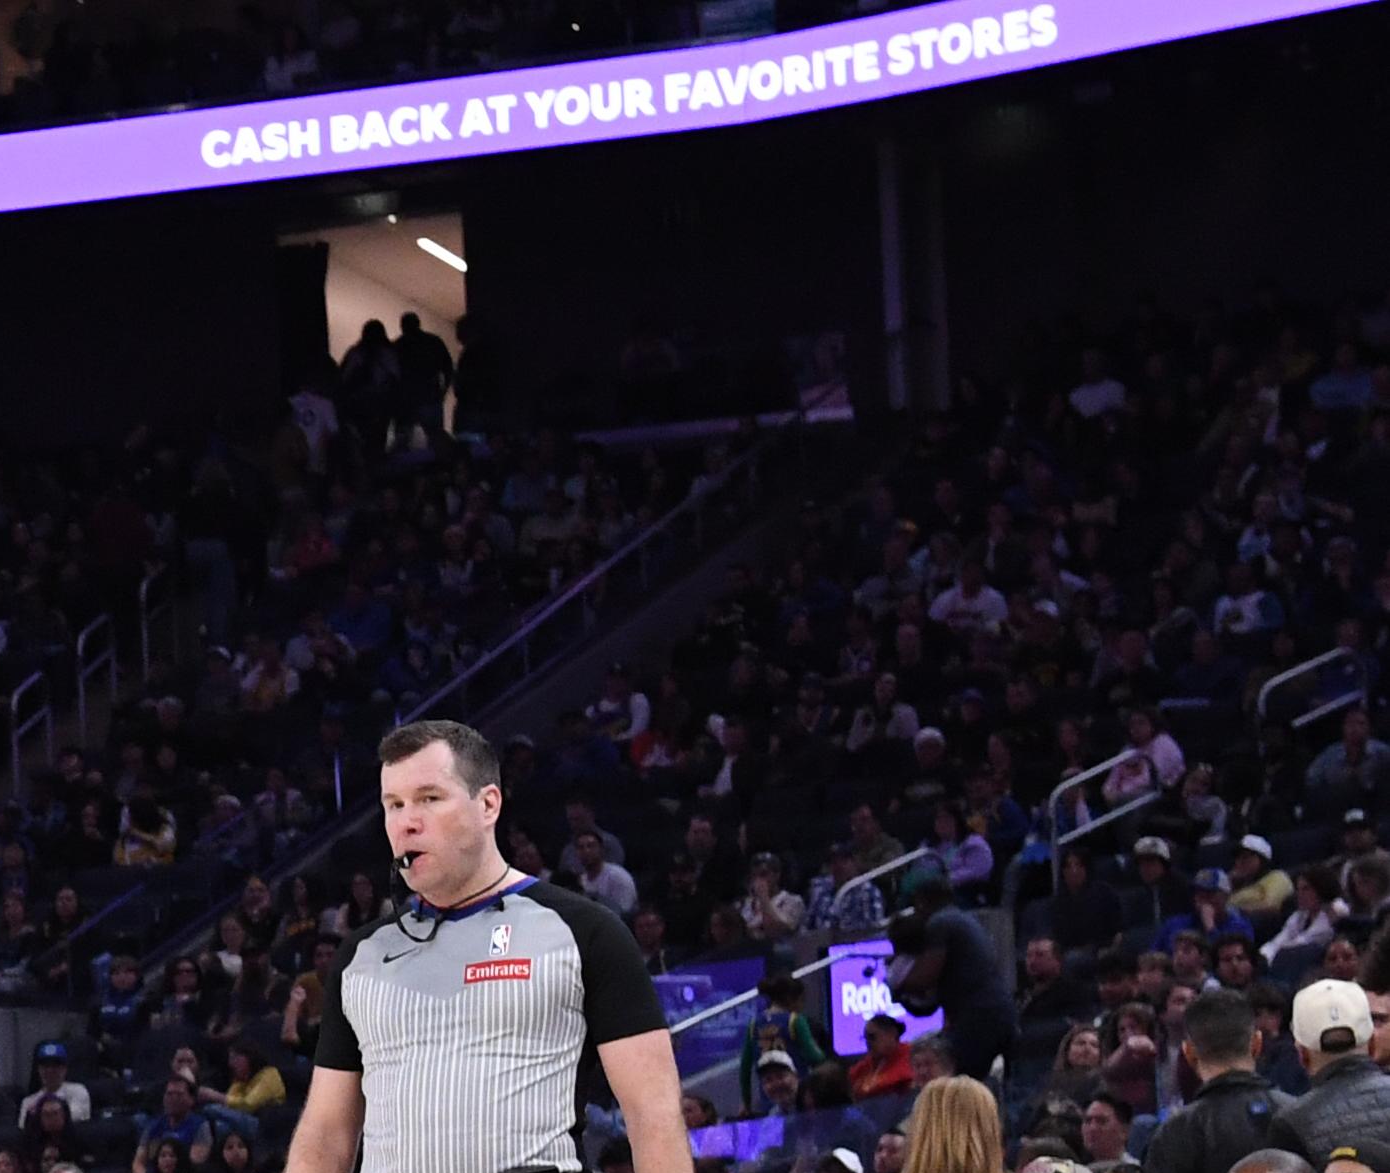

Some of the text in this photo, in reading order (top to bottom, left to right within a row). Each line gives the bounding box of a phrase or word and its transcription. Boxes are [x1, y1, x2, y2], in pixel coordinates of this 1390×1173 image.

[201, 4, 1058, 168] CASH BACK AT YOUR FAVORITE STORES
[466, 963, 530, 980] Emirates
